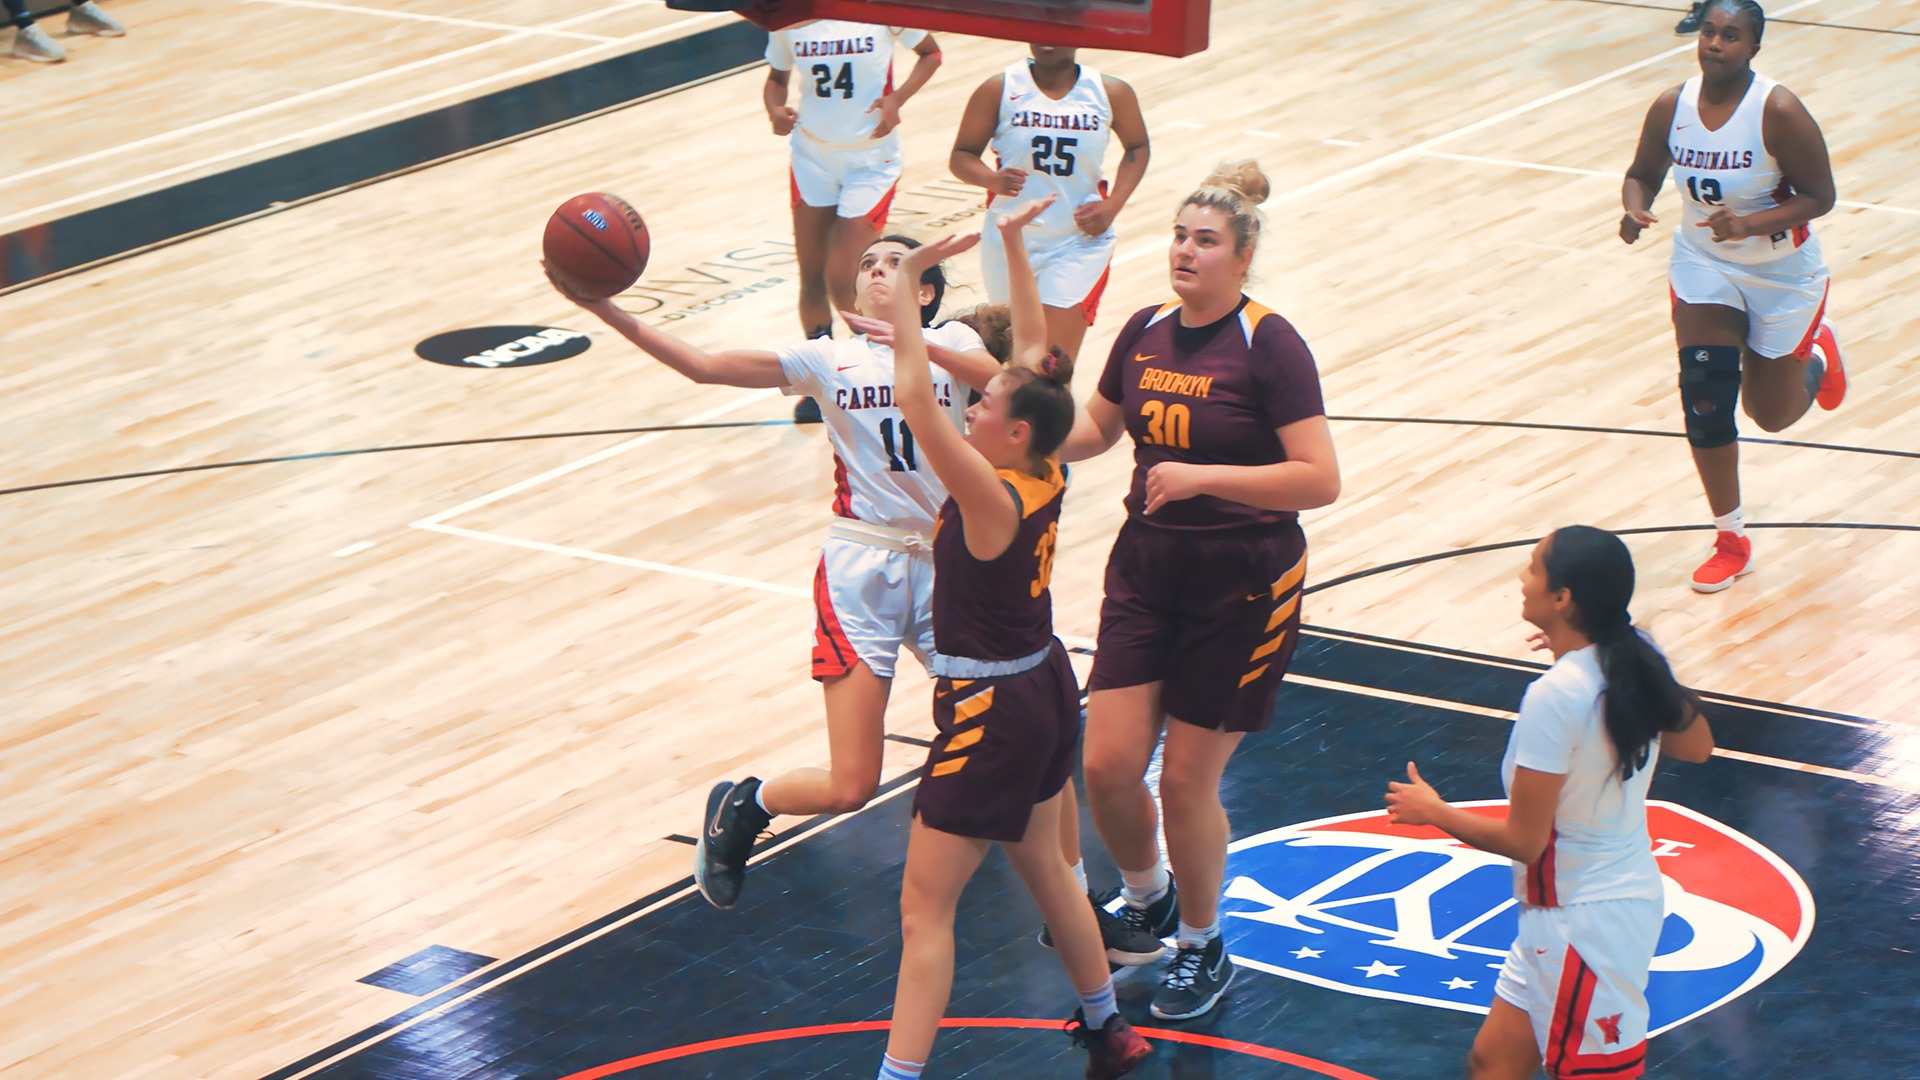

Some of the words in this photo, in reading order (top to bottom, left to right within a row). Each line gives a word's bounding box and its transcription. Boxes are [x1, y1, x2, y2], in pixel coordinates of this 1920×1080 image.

[794, 36, 874, 58] CARDINALS
[812, 62, 854, 99] 24
[1011, 111, 1100, 131] CARDINALS
[1031, 135, 1078, 177] 25
[1687, 176, 1727, 206] 12
[661, 277, 790, 320] DISCOVER
[462, 328, 585, 368] NCAA
[836, 383, 951, 410] CARDS
[1138, 367, 1214, 398] BROOKLYN
[1140, 400, 1191, 450] 30
[879, 418, 917, 472] 11
